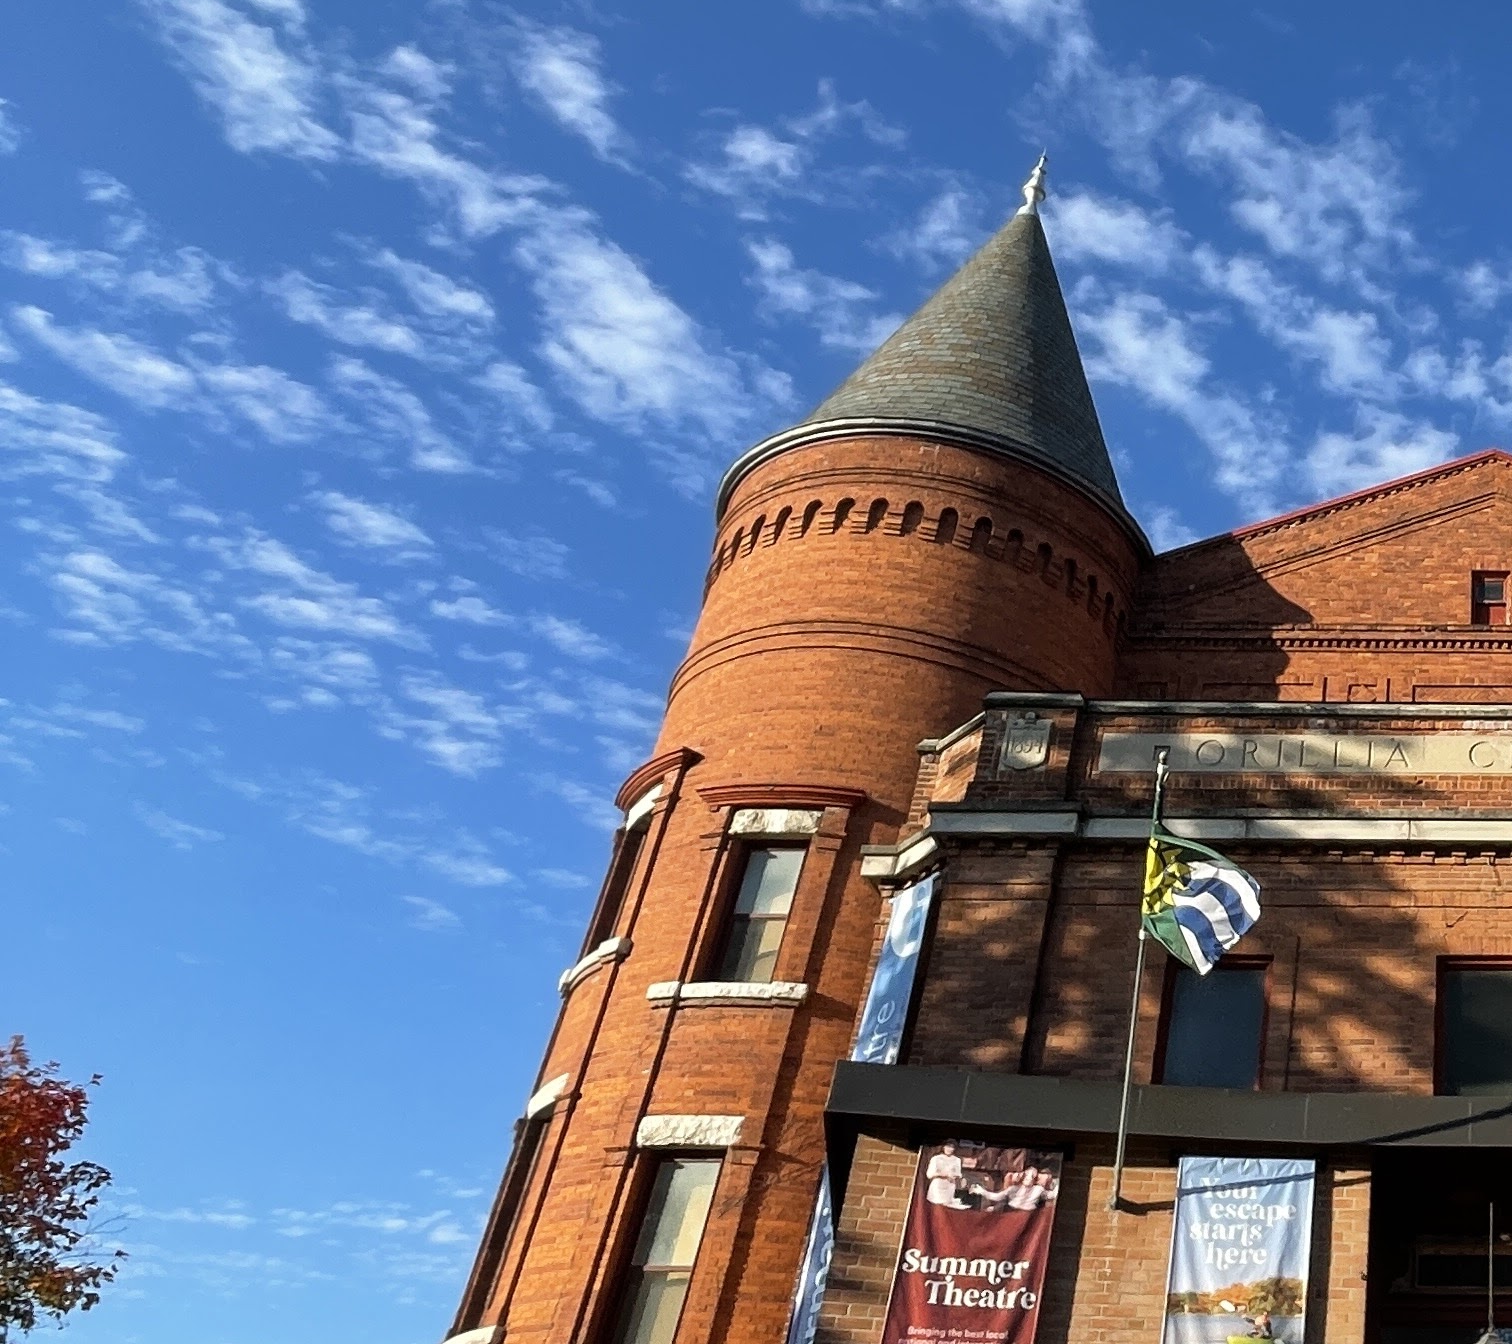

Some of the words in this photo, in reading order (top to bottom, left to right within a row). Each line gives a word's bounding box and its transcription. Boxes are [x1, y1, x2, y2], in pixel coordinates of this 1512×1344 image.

[1196, 739, 1411, 769] ORILLIA
[1200, 1176, 1257, 1200] Your
[1209, 1201, 1297, 1227] escape
[1190, 1220, 1262, 1246] starts
[901, 1247, 1030, 1286] Summer
[1205, 1241, 1267, 1270] here
[924, 1274, 1037, 1311] Theatre
[906, 1325, 946, 1338] Bringing
[948, 1327, 963, 1338] the
[964, 1328, 984, 1339] best
